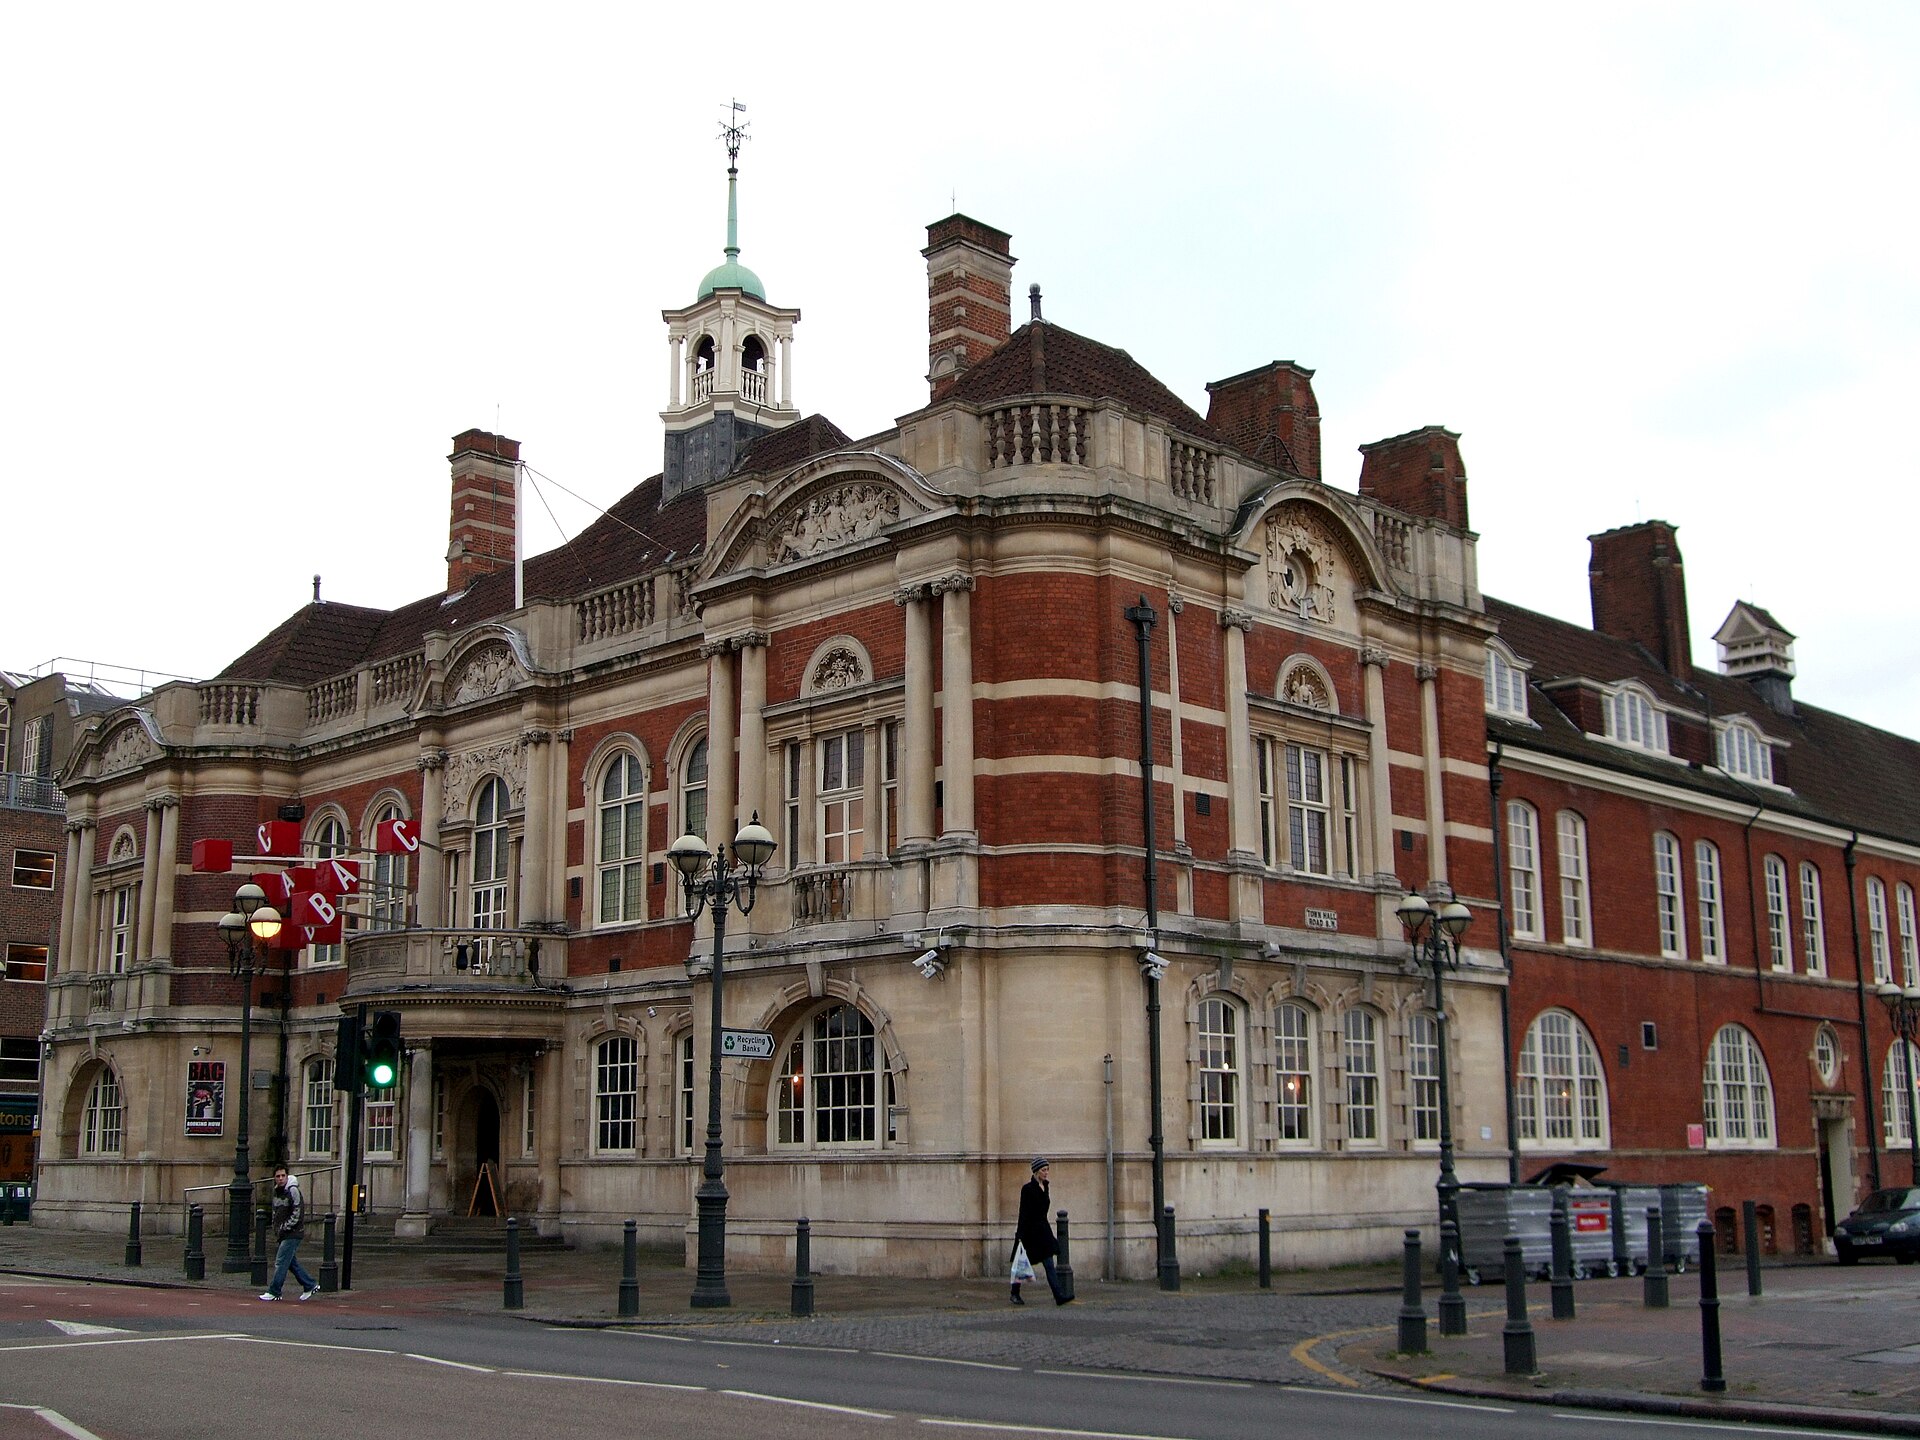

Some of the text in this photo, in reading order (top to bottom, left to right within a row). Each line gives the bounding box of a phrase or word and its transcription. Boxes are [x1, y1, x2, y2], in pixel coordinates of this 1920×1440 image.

[257, 825, 272, 853] C
[392, 820, 419, 851] C
[281, 870, 295, 898] A
[331, 860, 358, 891] A
[308, 892, 336, 925] B
[1307, 909, 1337, 920] TOWN HALL
[1308, 918, 1323, 927] ROAD
[737, 1035, 766, 1045] Recycling
[742, 1044, 761, 1052] Banks
[188, 1062, 223, 1081] BAC
